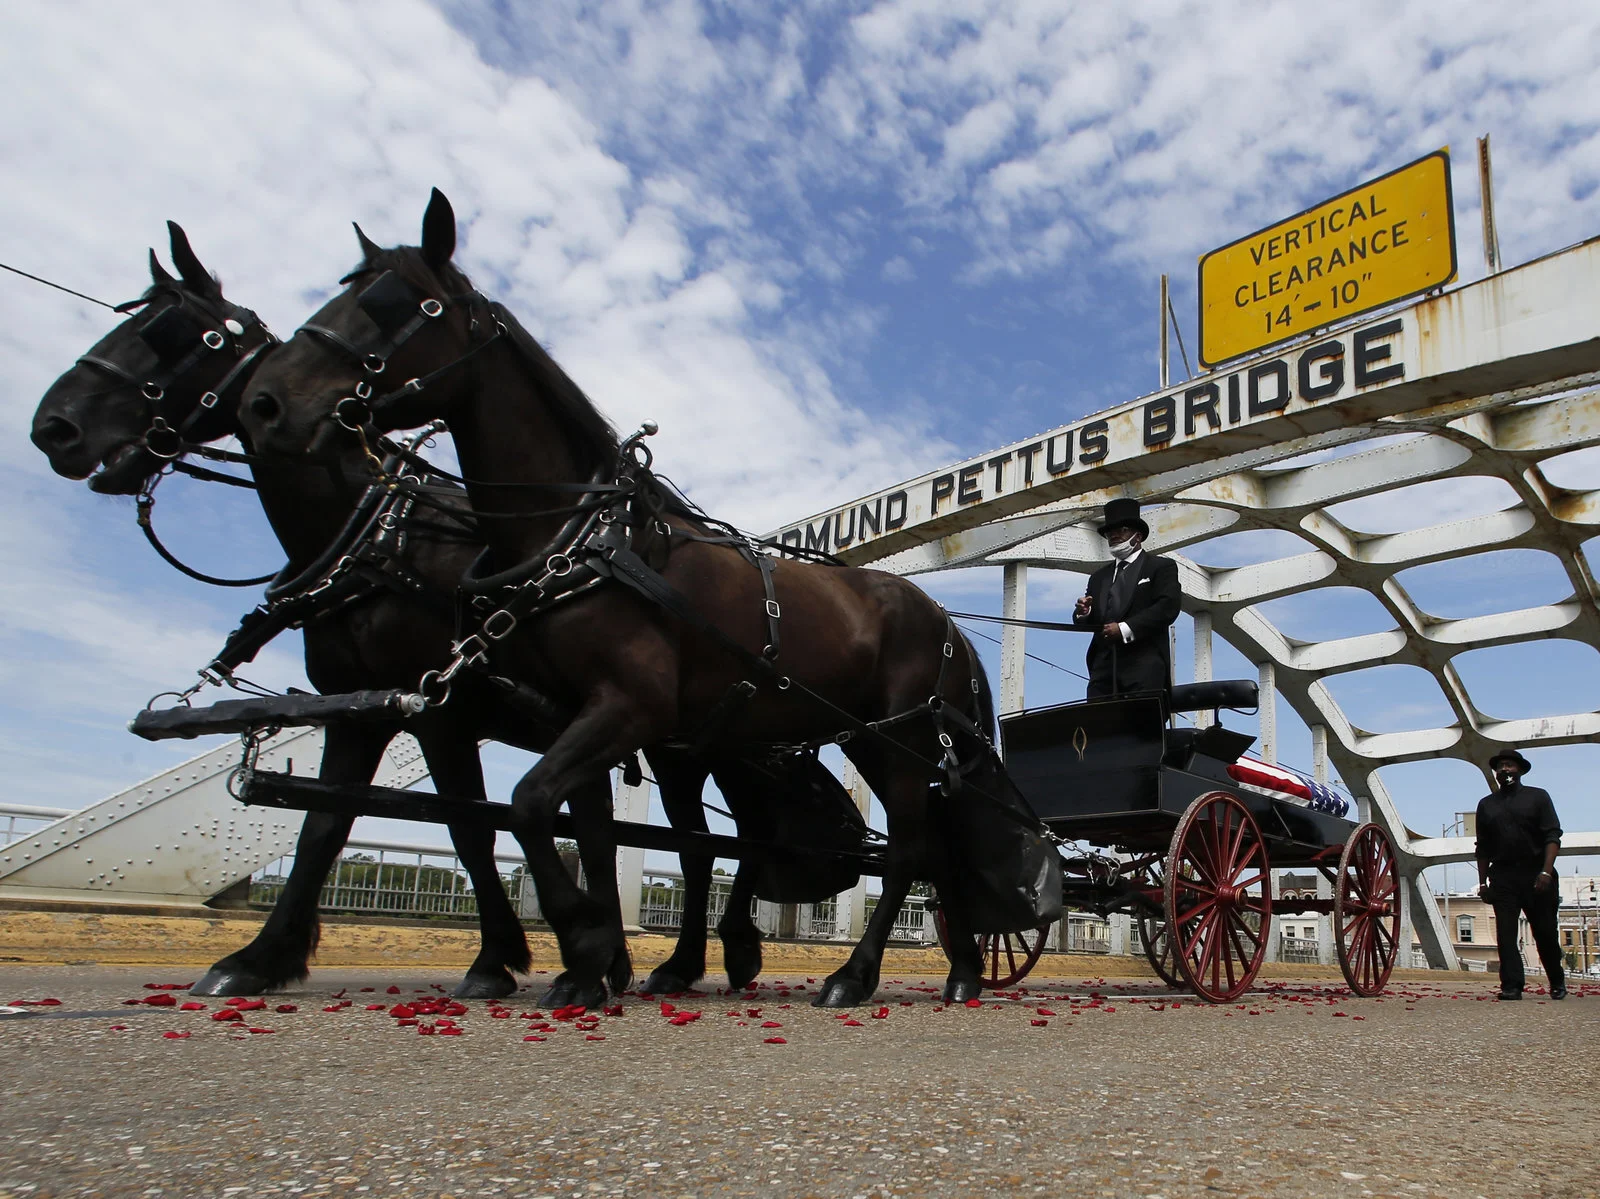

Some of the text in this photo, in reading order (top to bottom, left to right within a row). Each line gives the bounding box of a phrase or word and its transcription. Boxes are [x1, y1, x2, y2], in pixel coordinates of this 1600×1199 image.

[1234, 220, 1410, 308] CLEARANCE
[1250, 195, 1387, 266] VERTICAL
[931, 419, 1110, 516] PETTUS
[1143, 317, 1406, 447] BRIDGE
